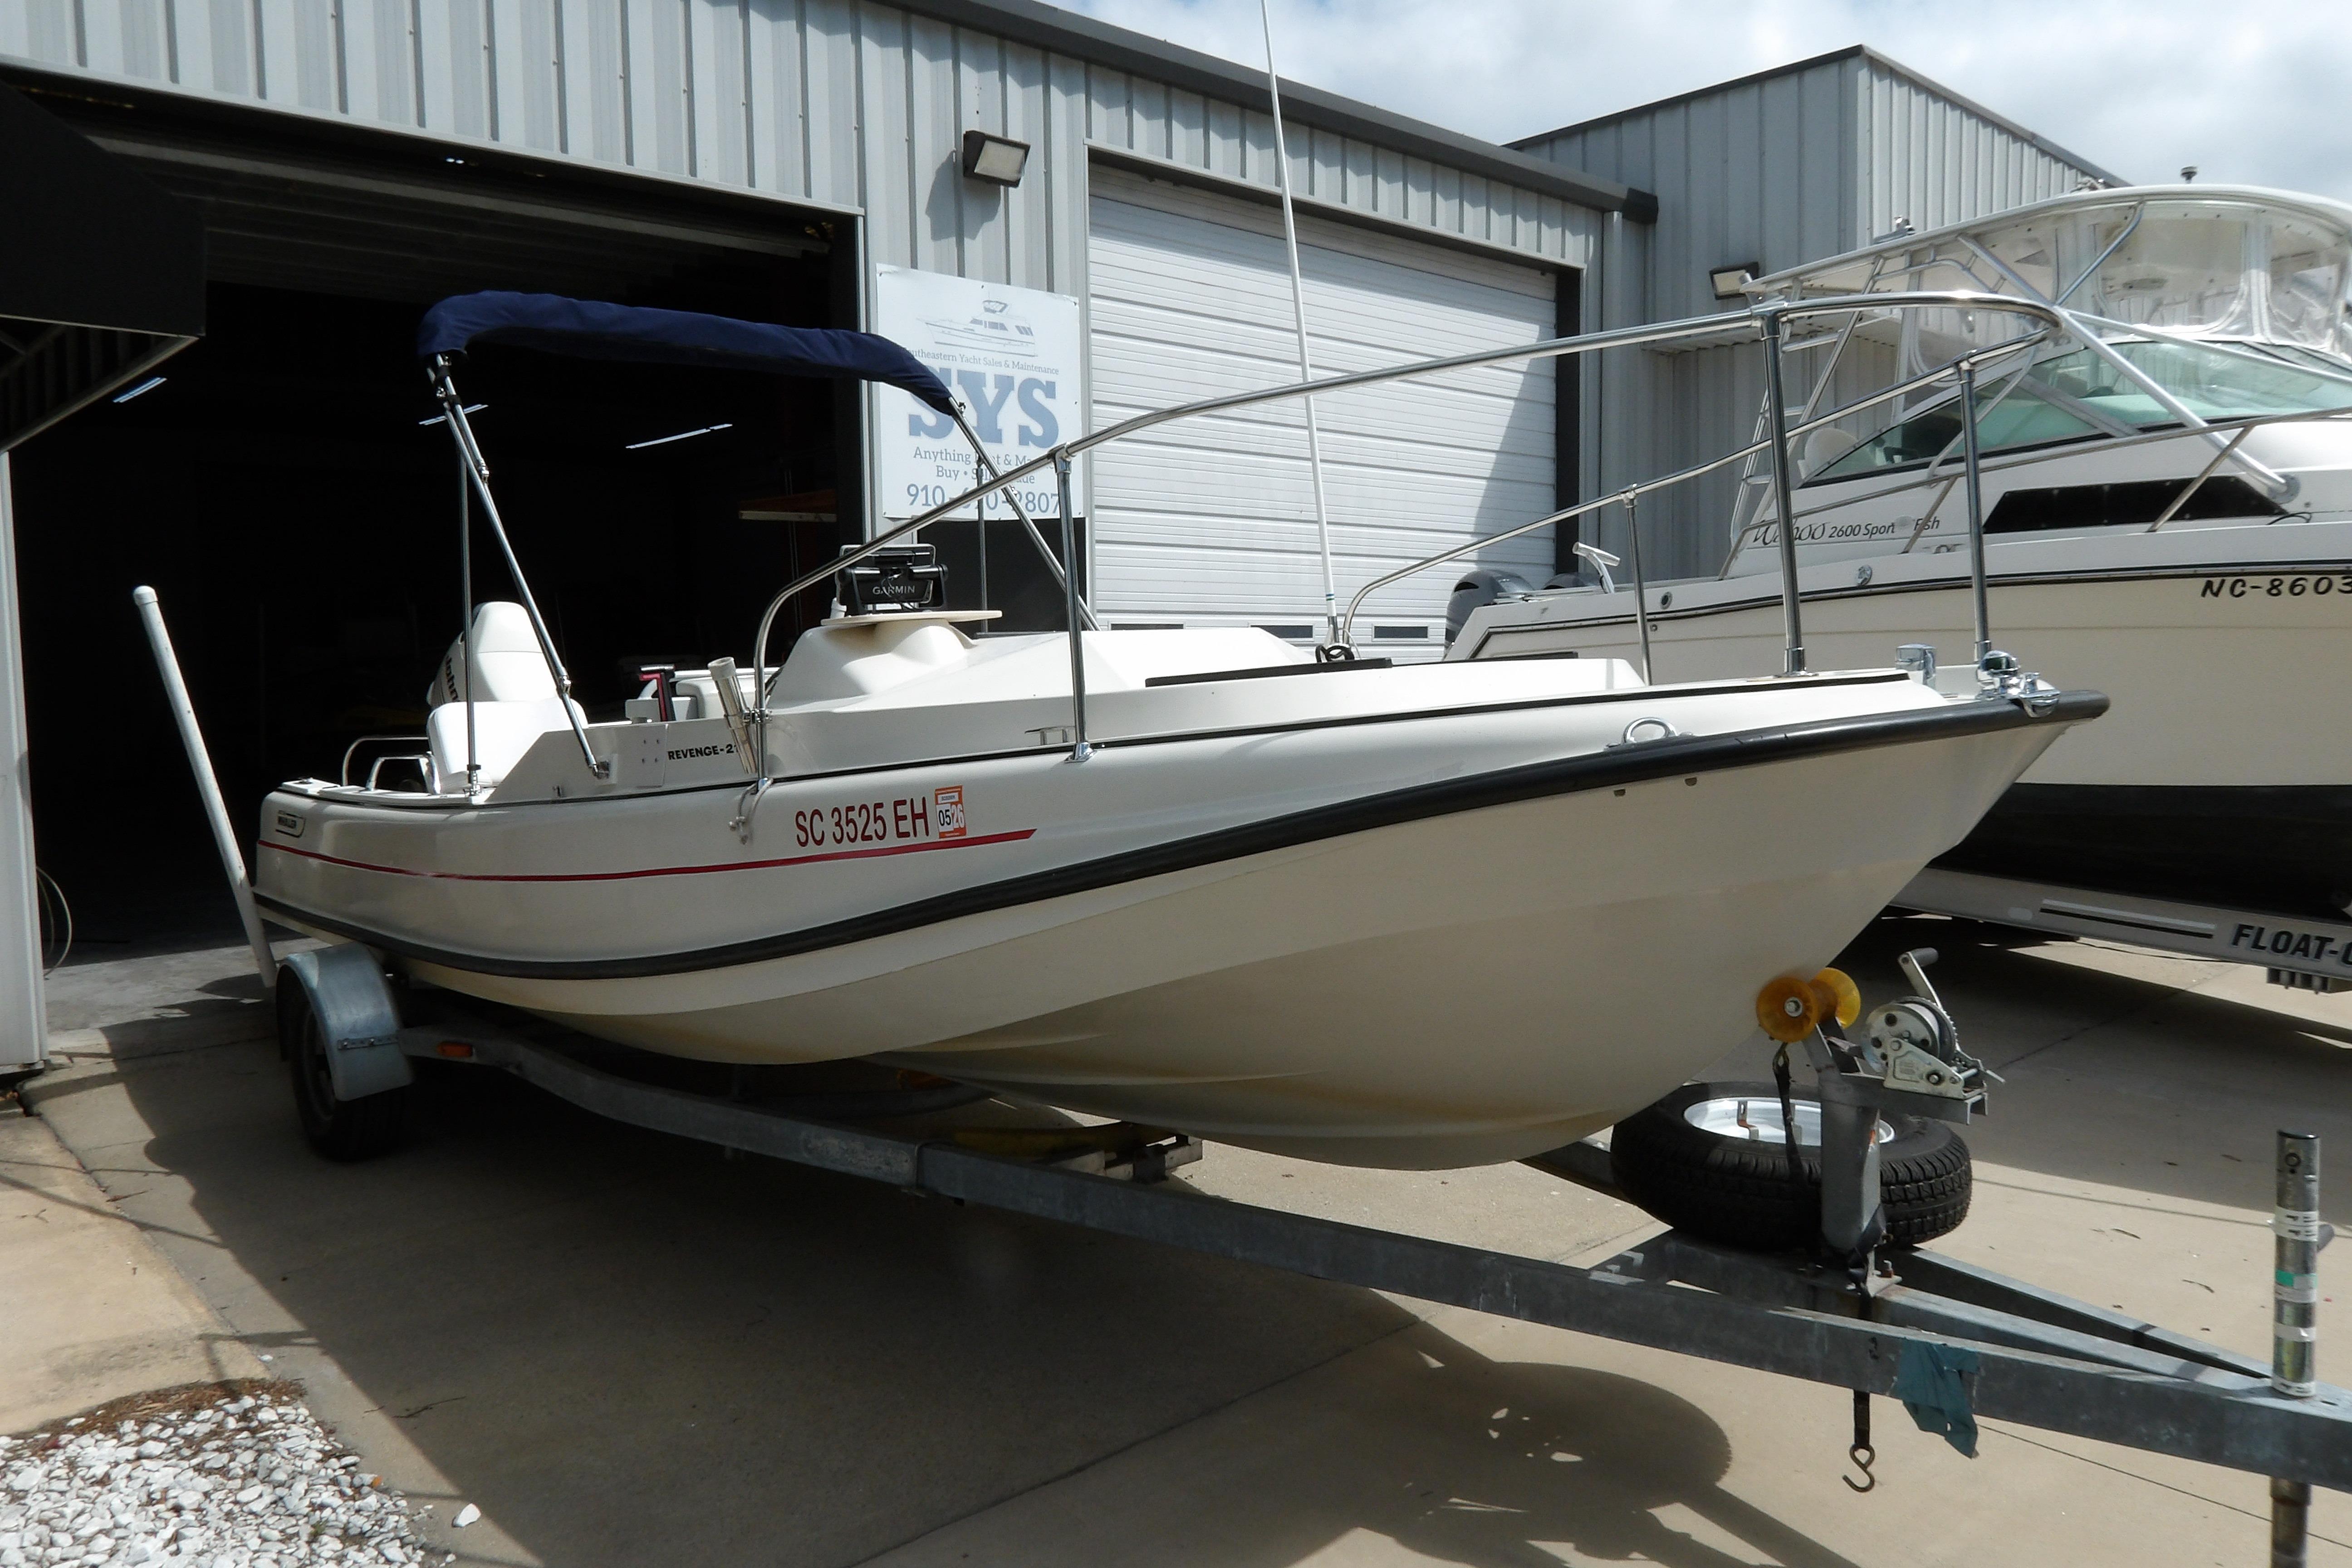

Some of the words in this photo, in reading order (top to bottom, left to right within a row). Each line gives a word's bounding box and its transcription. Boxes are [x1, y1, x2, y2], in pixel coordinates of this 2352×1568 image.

[909, 349, 957, 362] utheastern
[959, 354, 981, 364] Yacht
[983, 357, 1002, 367] Sales
[1004, 360, 1010, 368] &
[1012, 361, 1059, 375] Maintenance
[913, 446, 971, 465] Anything
[936, 465, 960, 481] Buy
[1828, 524, 1861, 538] 2600
[1863, 523, 1895, 539] Sport
[1913, 516, 1940, 531] Fsh
[2201, 576, 2352, 598] NC-8603
[795, 809, 824, 847] SC
[831, 802, 887, 844] 3525
[893, 796, 929, 838] EH
[938, 809, 951, 826] 05
